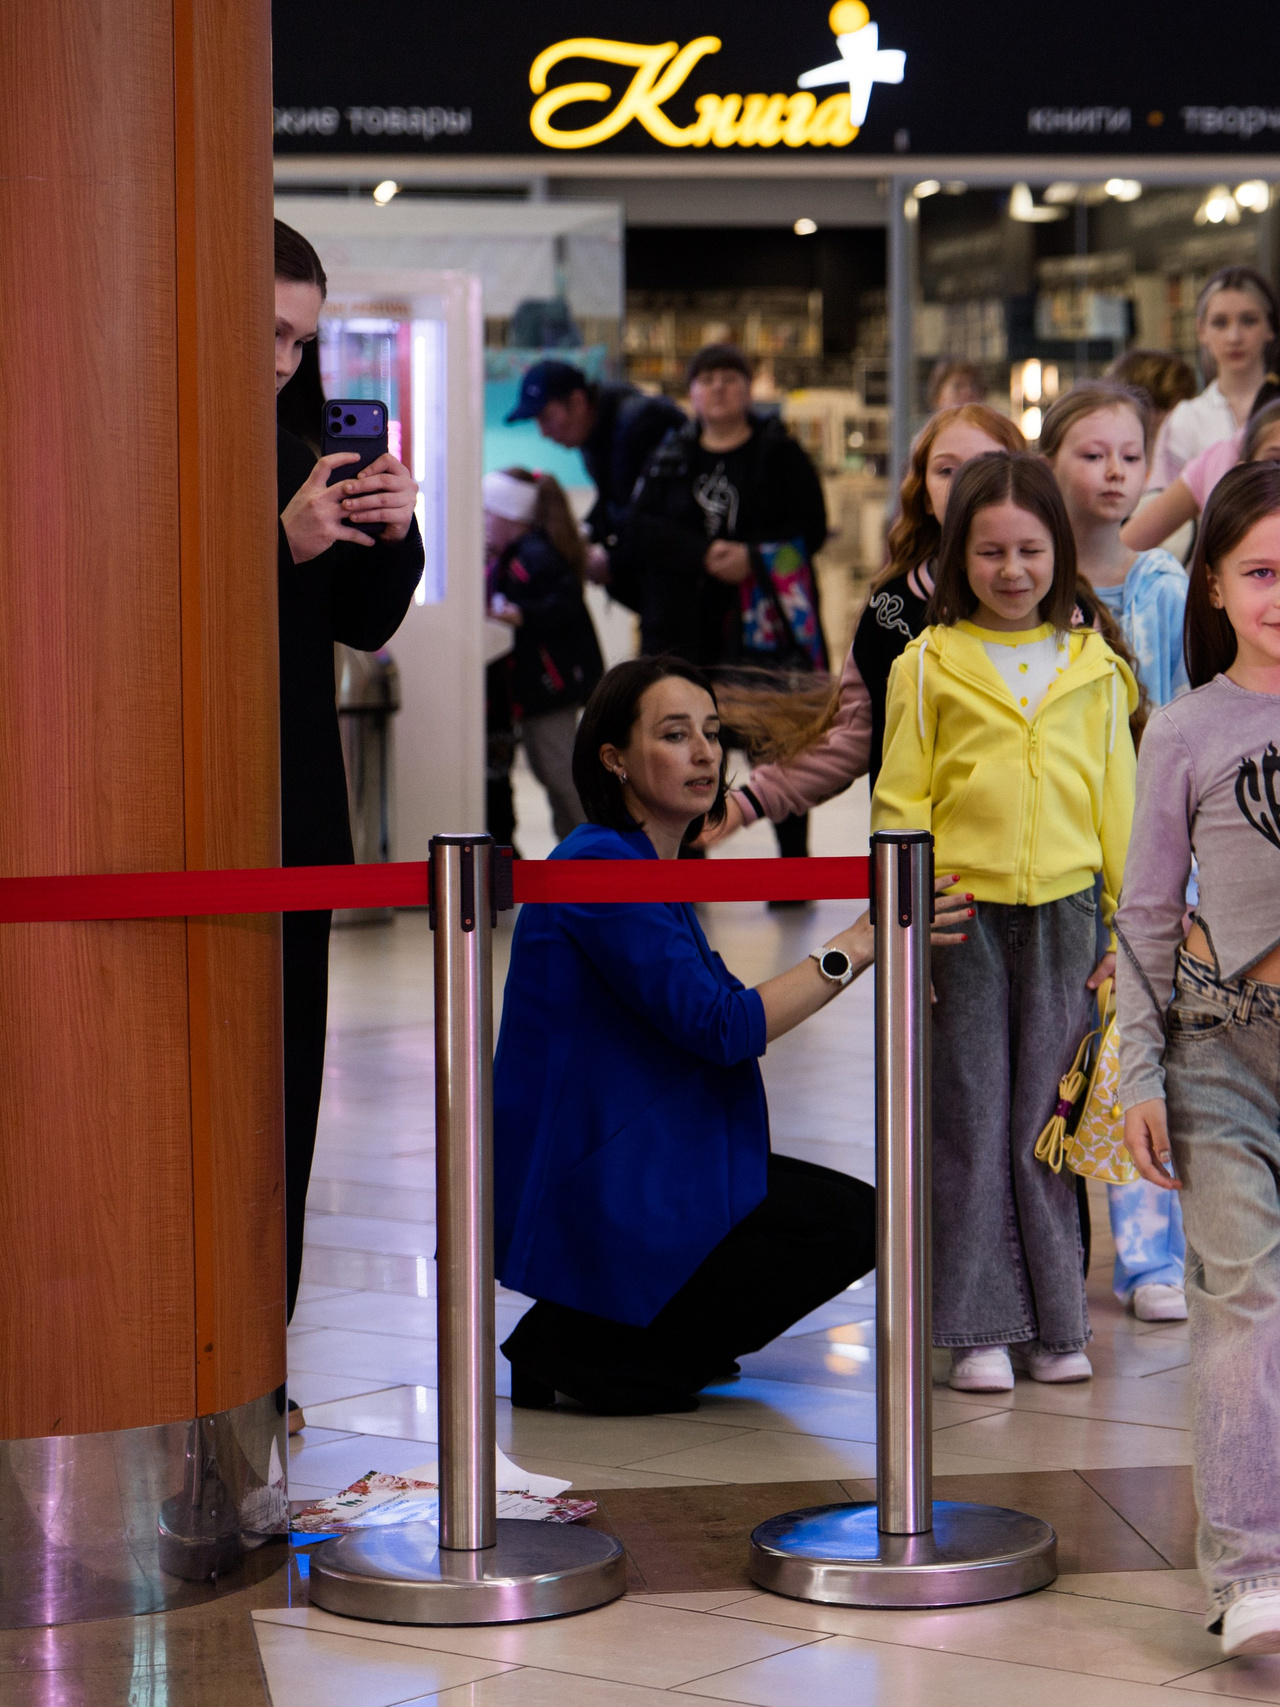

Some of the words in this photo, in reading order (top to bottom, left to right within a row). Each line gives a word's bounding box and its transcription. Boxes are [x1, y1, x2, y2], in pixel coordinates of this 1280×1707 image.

[273, 106, 340, 136] кие
[347, 106, 473, 141] товары
[1028, 106, 1131, 133] книги
